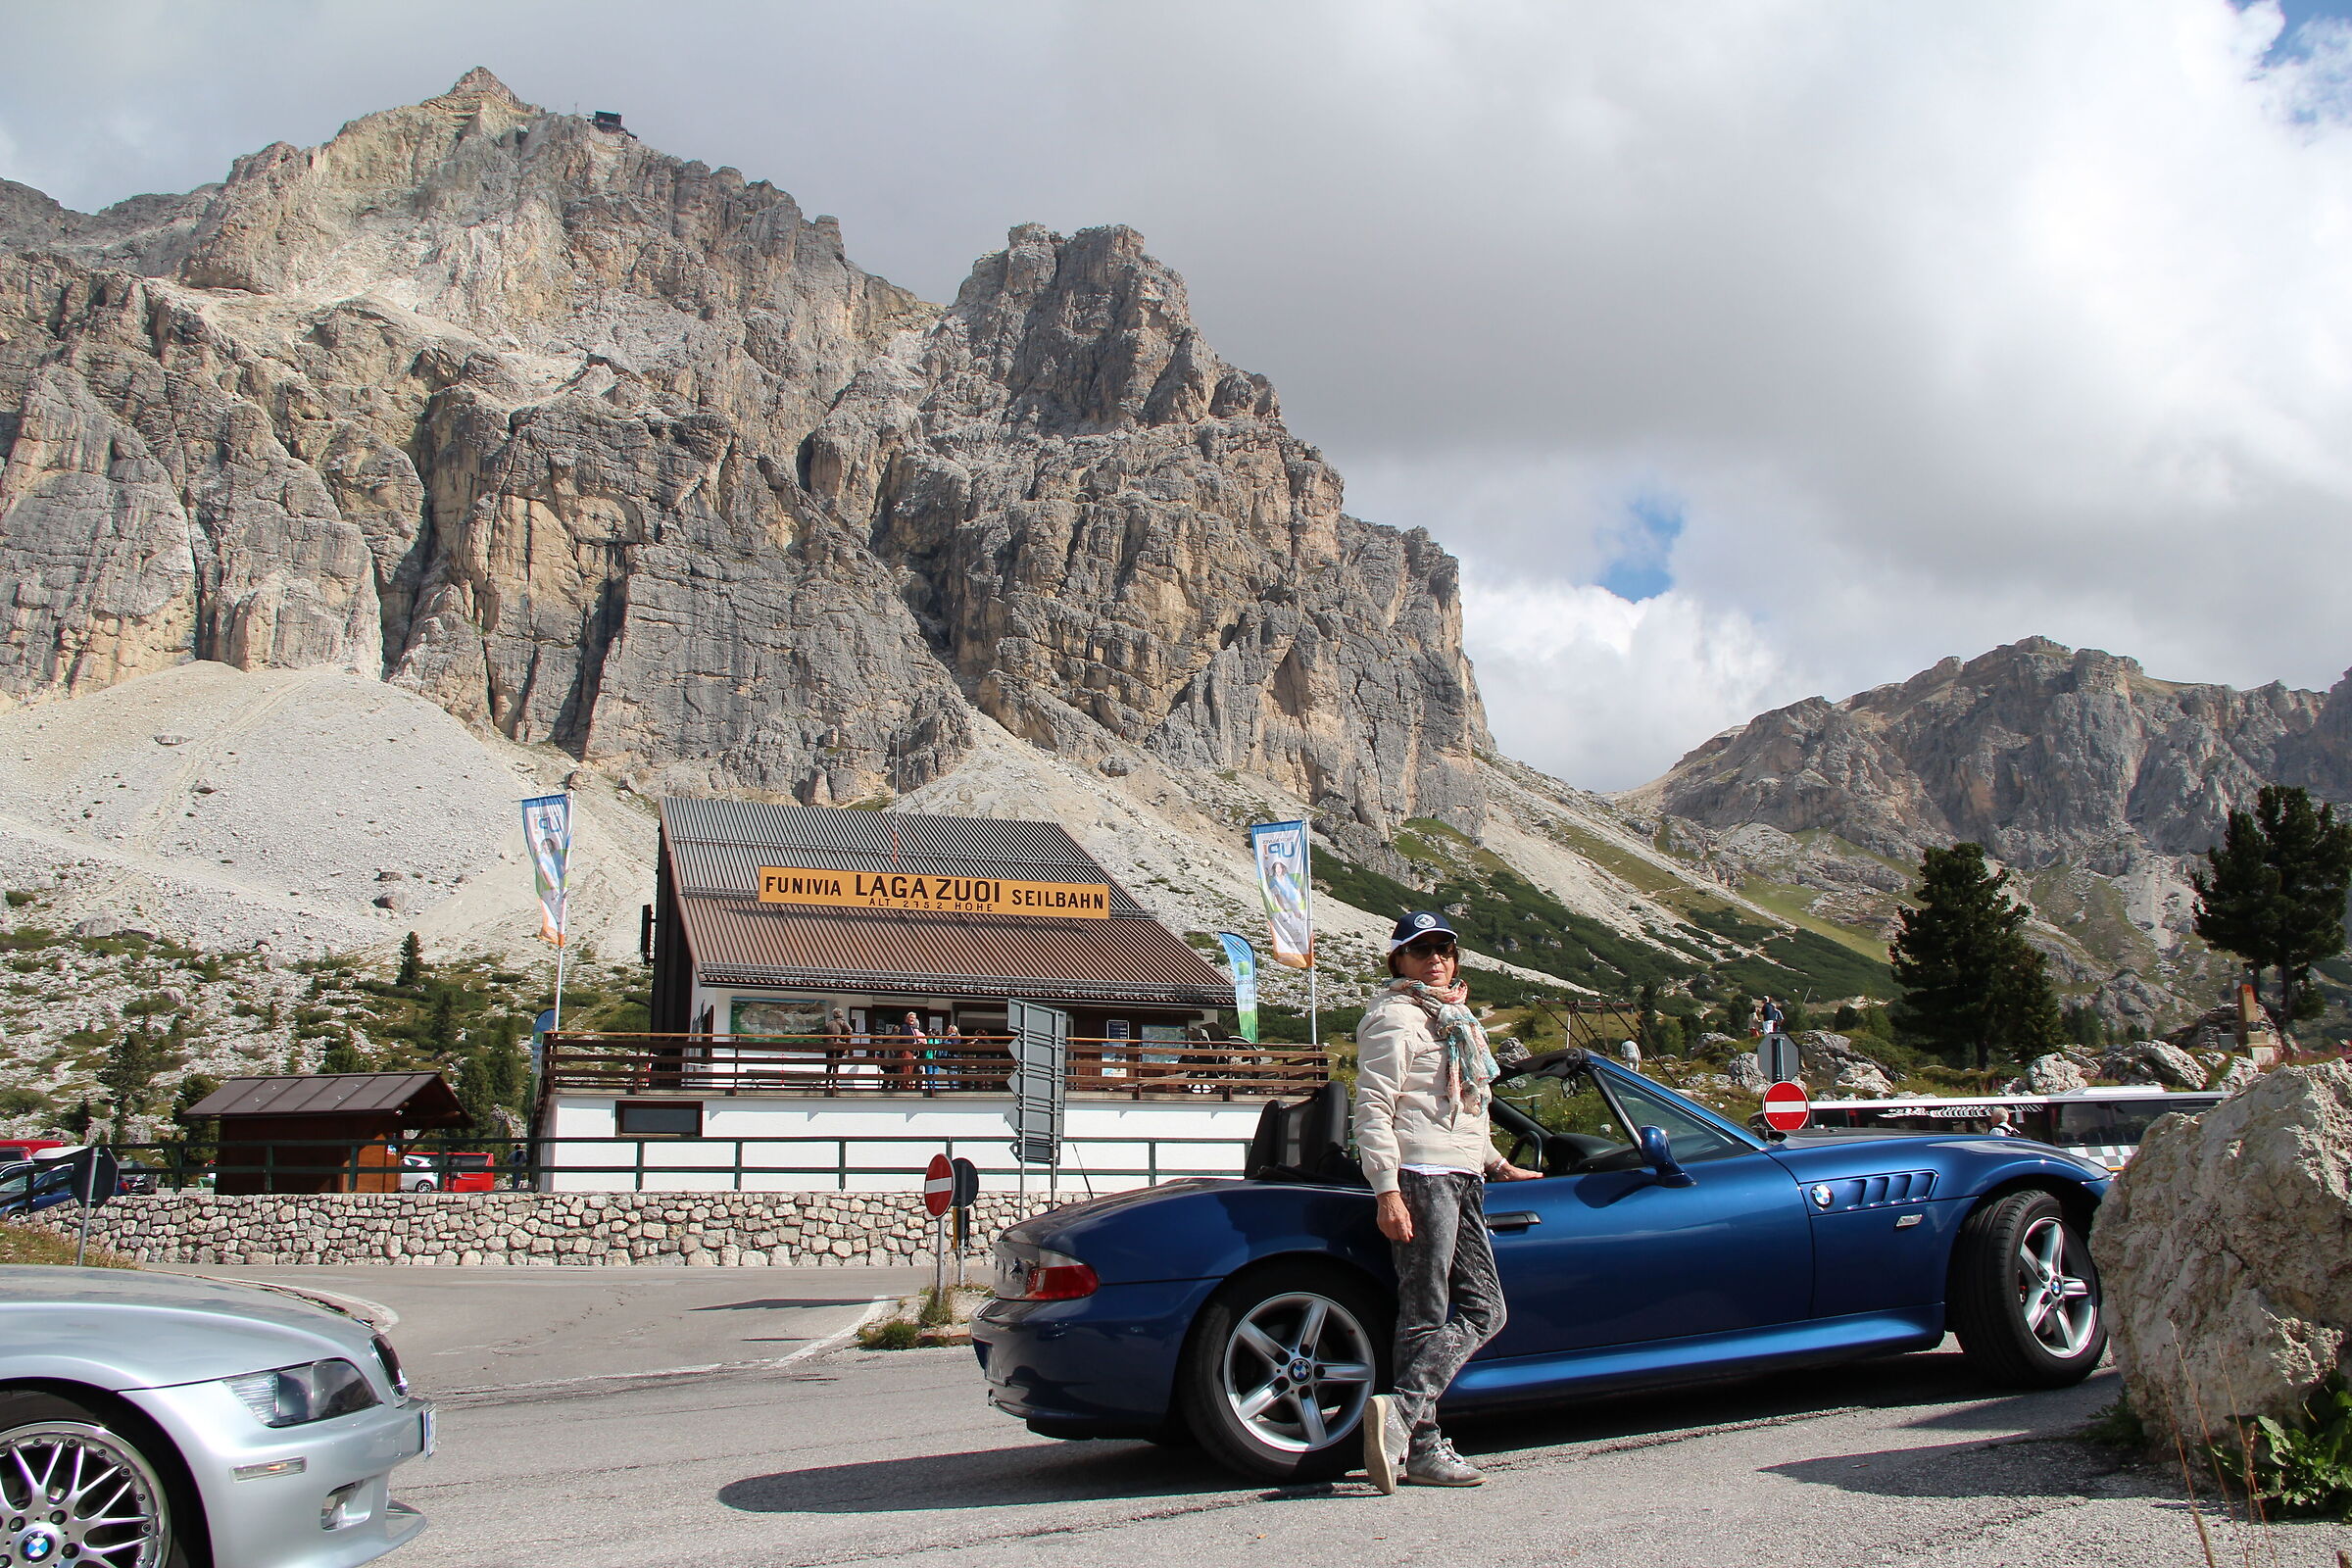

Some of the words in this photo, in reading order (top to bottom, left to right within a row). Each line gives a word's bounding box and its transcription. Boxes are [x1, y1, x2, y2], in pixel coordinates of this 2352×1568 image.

[765, 876, 842, 896] FUNIVIA
[856, 874, 1000, 903] LAGAZUOI
[1011, 889, 1103, 909] SEILBAHN
[868, 898, 893, 906] ALT.
